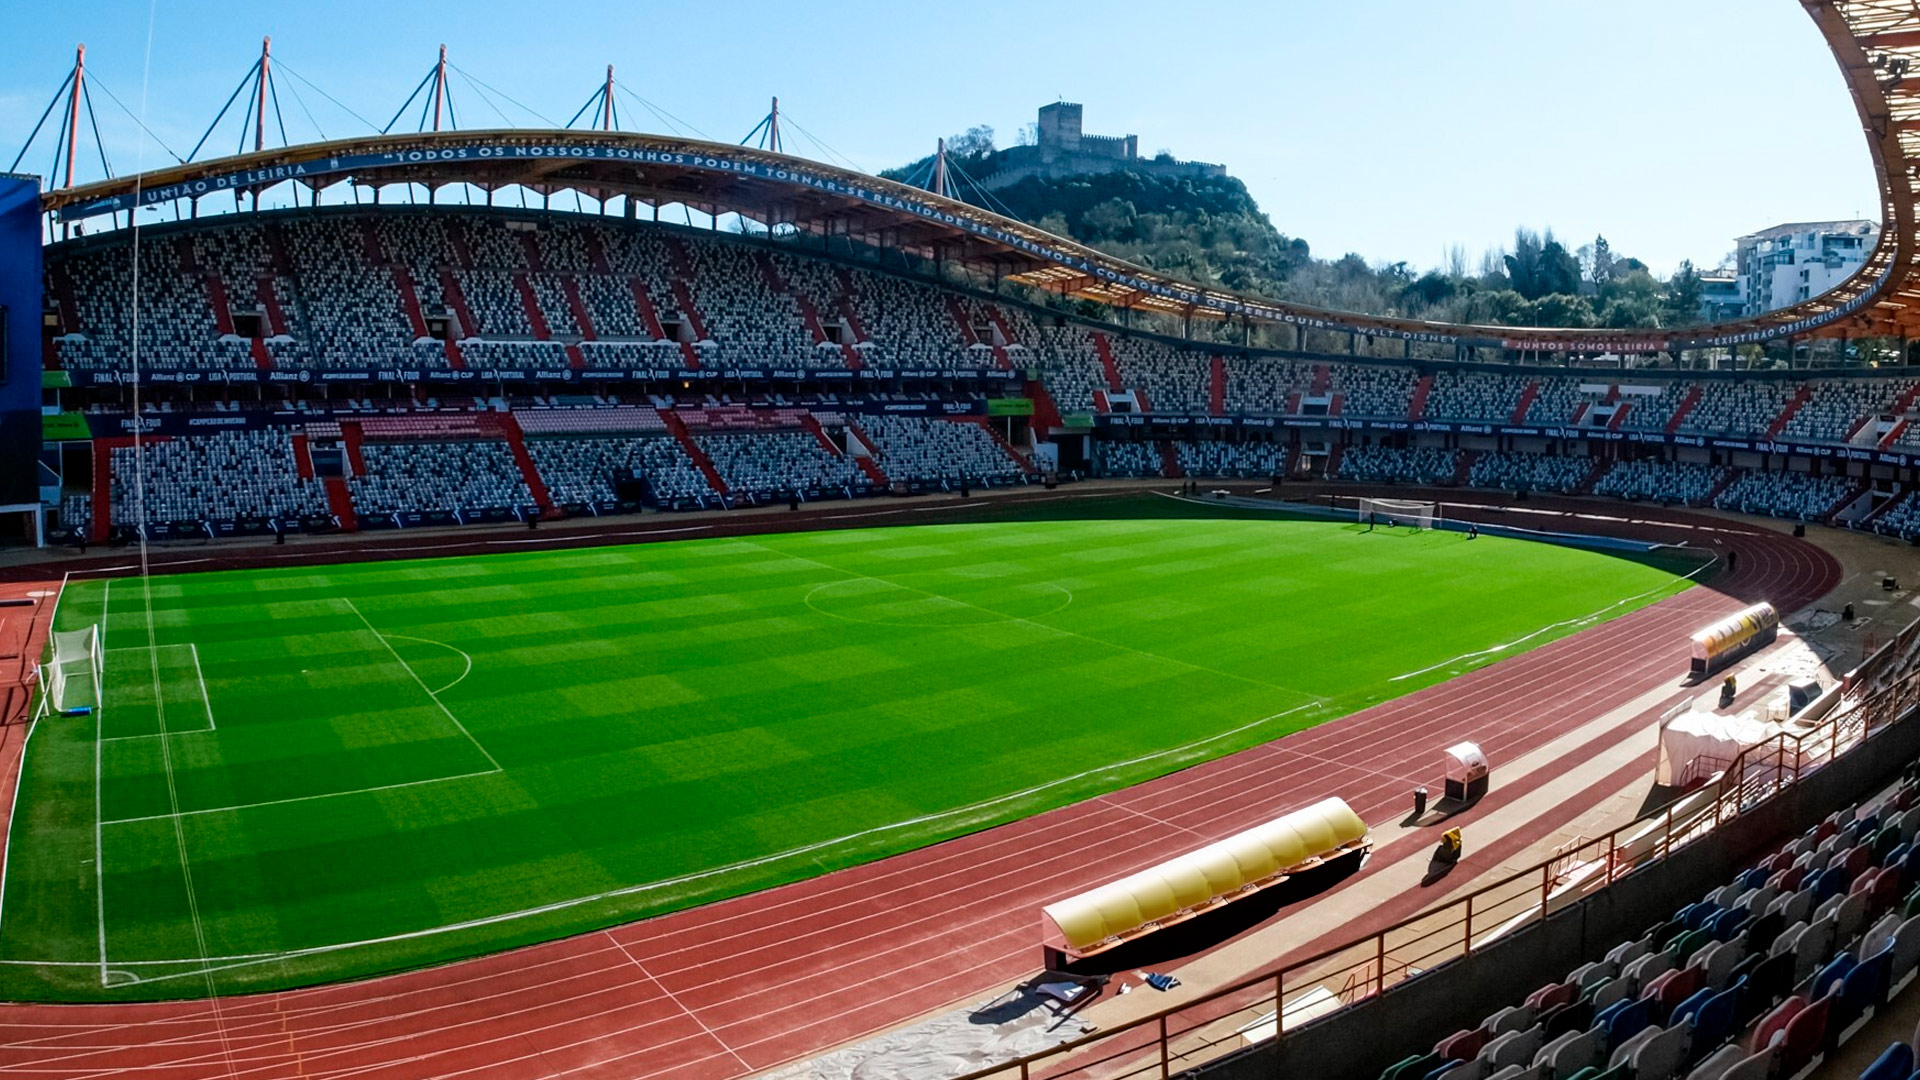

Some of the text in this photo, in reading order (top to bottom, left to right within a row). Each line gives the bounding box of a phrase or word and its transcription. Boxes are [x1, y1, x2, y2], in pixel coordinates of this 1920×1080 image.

[147, 164, 306, 202] UNIÃO DE LEIRIA
[479, 147, 504, 157] OS
[515, 147, 596, 157] NOSSOS
[606, 148, 684, 163] SONHOS
[694, 157, 756, 174] PODEM
[765, 167, 865, 199] TORNAR-SE
[873, 194, 964, 226] REALIDADE
[971, 223, 989, 234] SE
[996, 231, 1072, 264] TIVERMOS
[1096, 268, 1171, 296] CORAGEM
[1180, 292, 1198, 302] DE
[1207, 298, 1226, 309] OS
[1357, 326, 1458, 344] WALT DISNEY
[1515, 342, 1655, 350] JUNTOS SOMOS LEIRIA
[93, 373, 113, 383] FINAL
[151, 373, 201, 381] Allianz CUP
[208, 372, 258, 381] LIGA PORTUGAL
[269, 371, 298, 381] Allianz
[378, 371, 395, 380] FINAL
[429, 371, 474, 379] Allianz CUP
[535, 371, 561, 379] Allianz
[773, 370, 796, 378] Allianz
[121, 419, 137, 428] FINA
